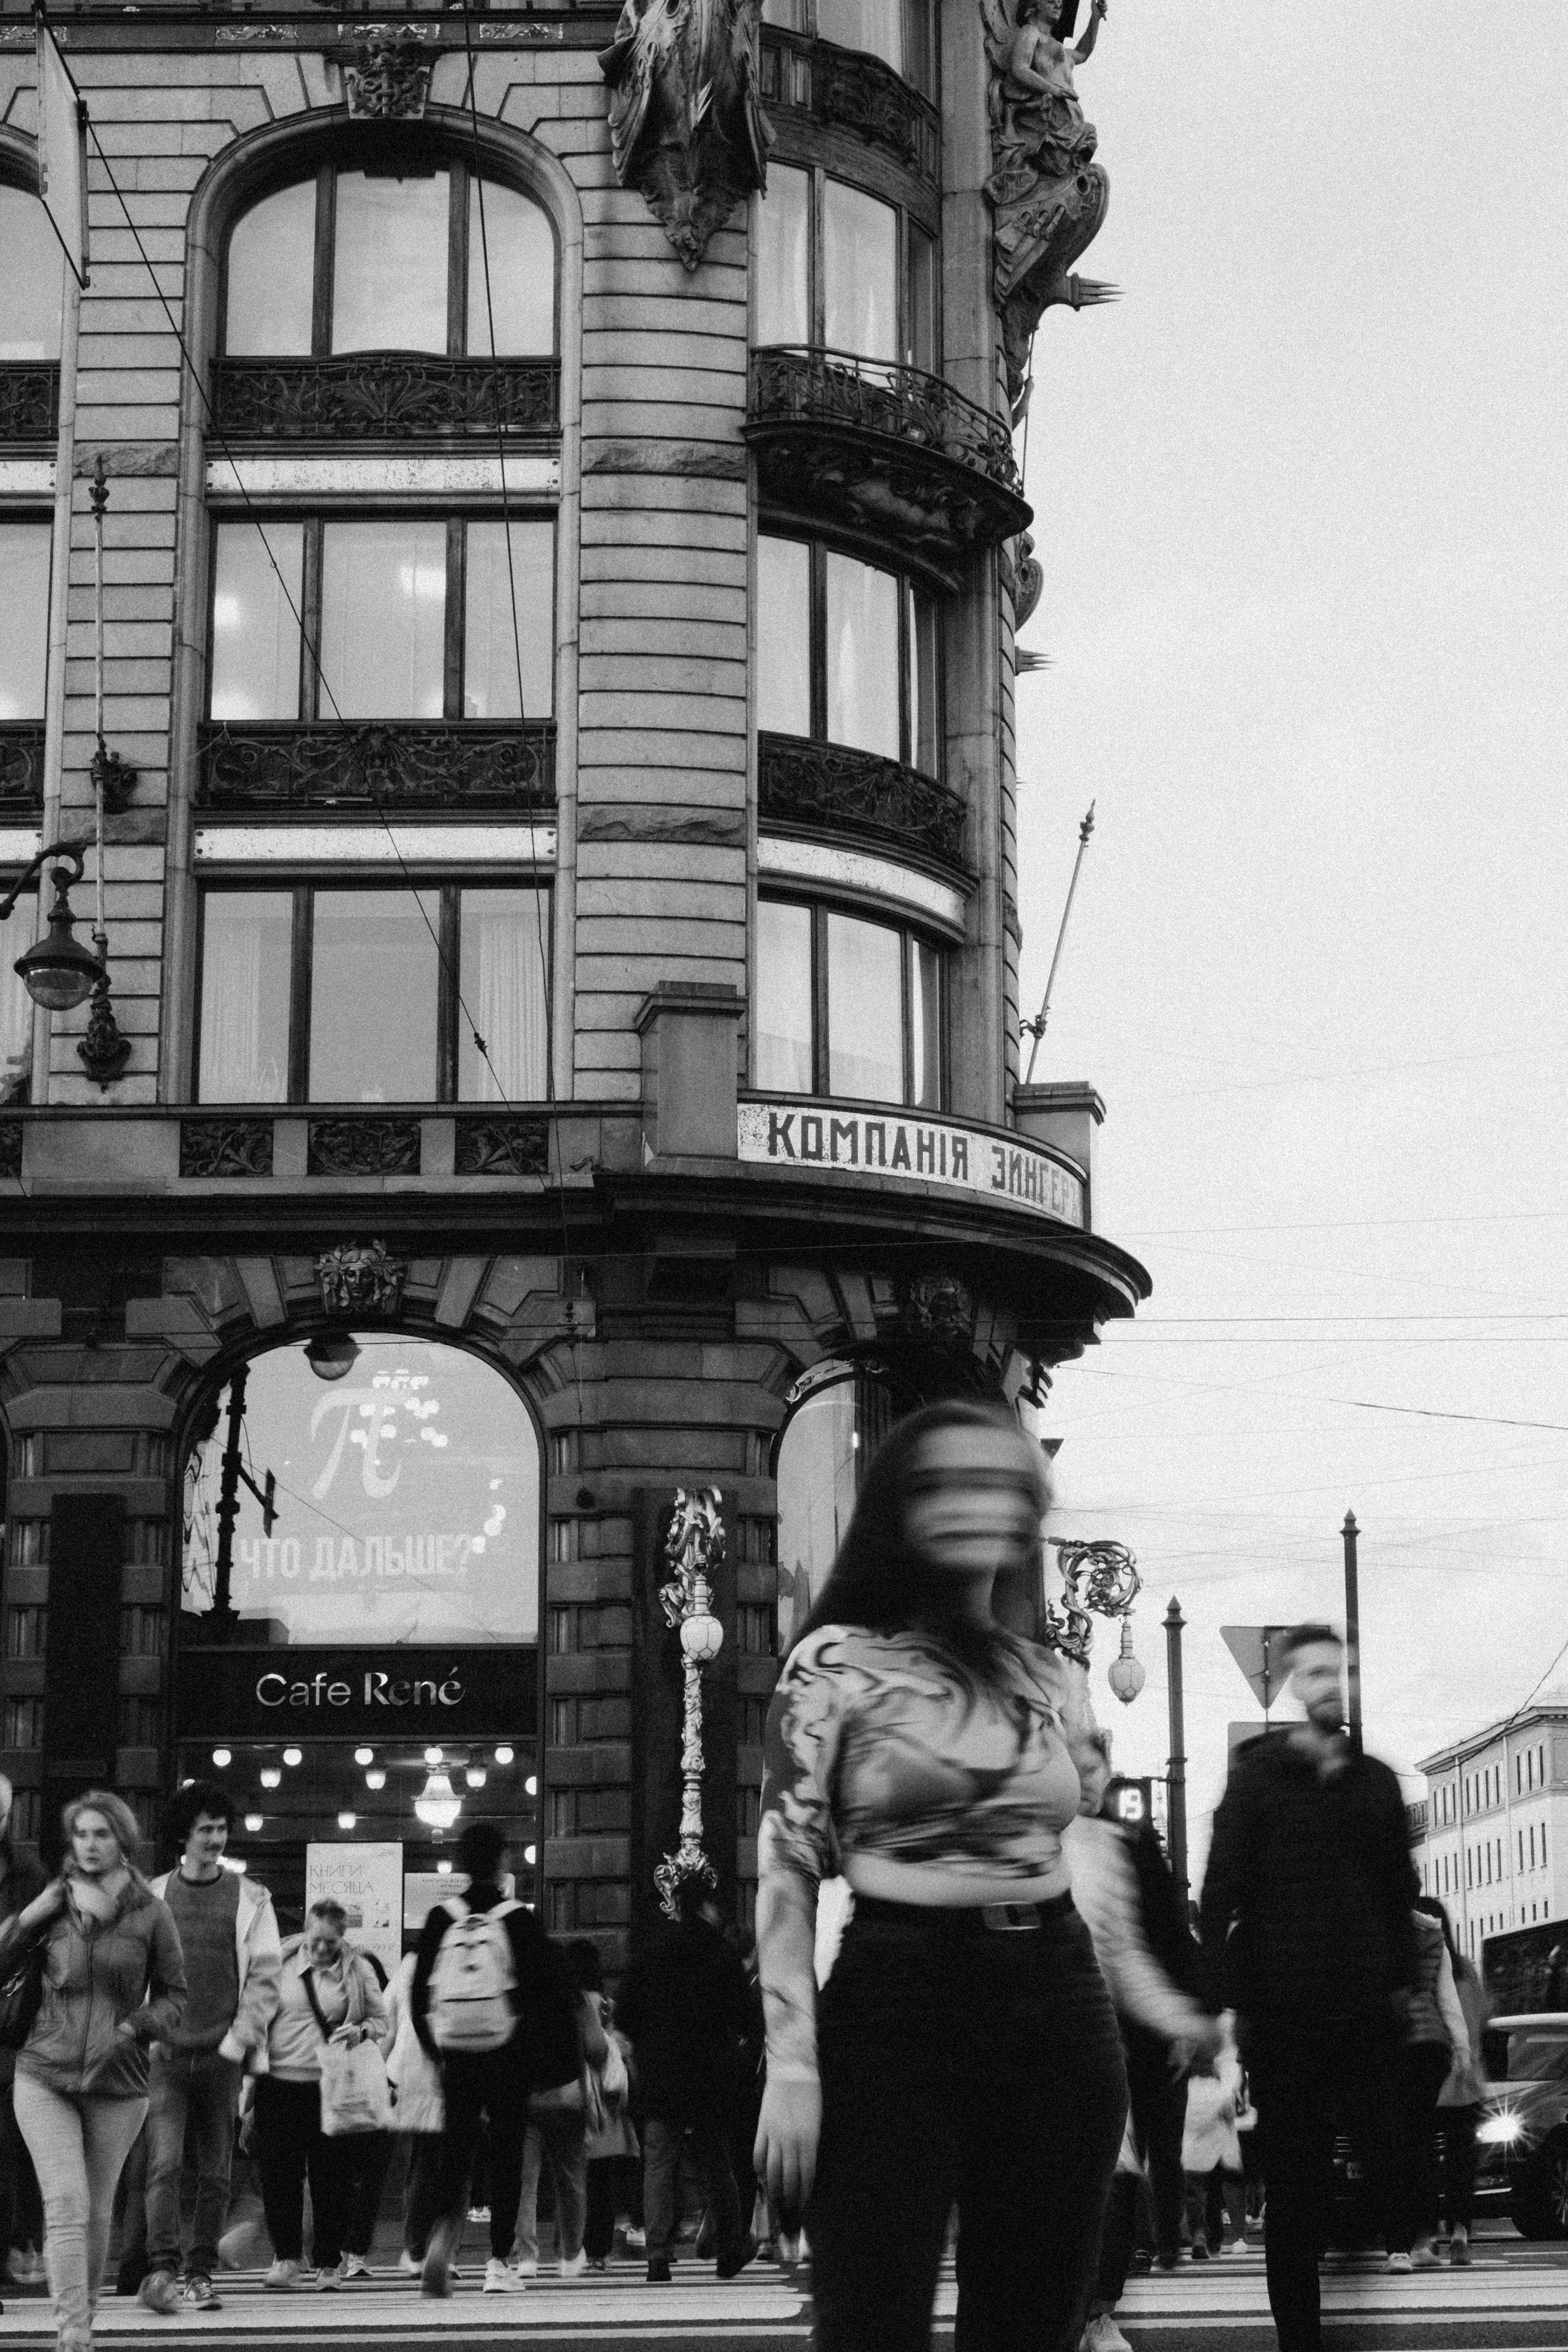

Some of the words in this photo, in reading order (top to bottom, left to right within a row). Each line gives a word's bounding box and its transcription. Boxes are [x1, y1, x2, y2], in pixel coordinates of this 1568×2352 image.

[769, 1112, 968, 1181] КОМПАНІЯ
[239, 1537, 300, 1578] ЧТО
[310, 1534, 472, 1581] ДАЛЬШЕ?
[256, 1672, 351, 1706] Cafe
[364, 1666, 466, 1705] René
[310, 1864, 362, 1877] КНИГИ
[310, 1882, 374, 1894] МЕСЯЦА
